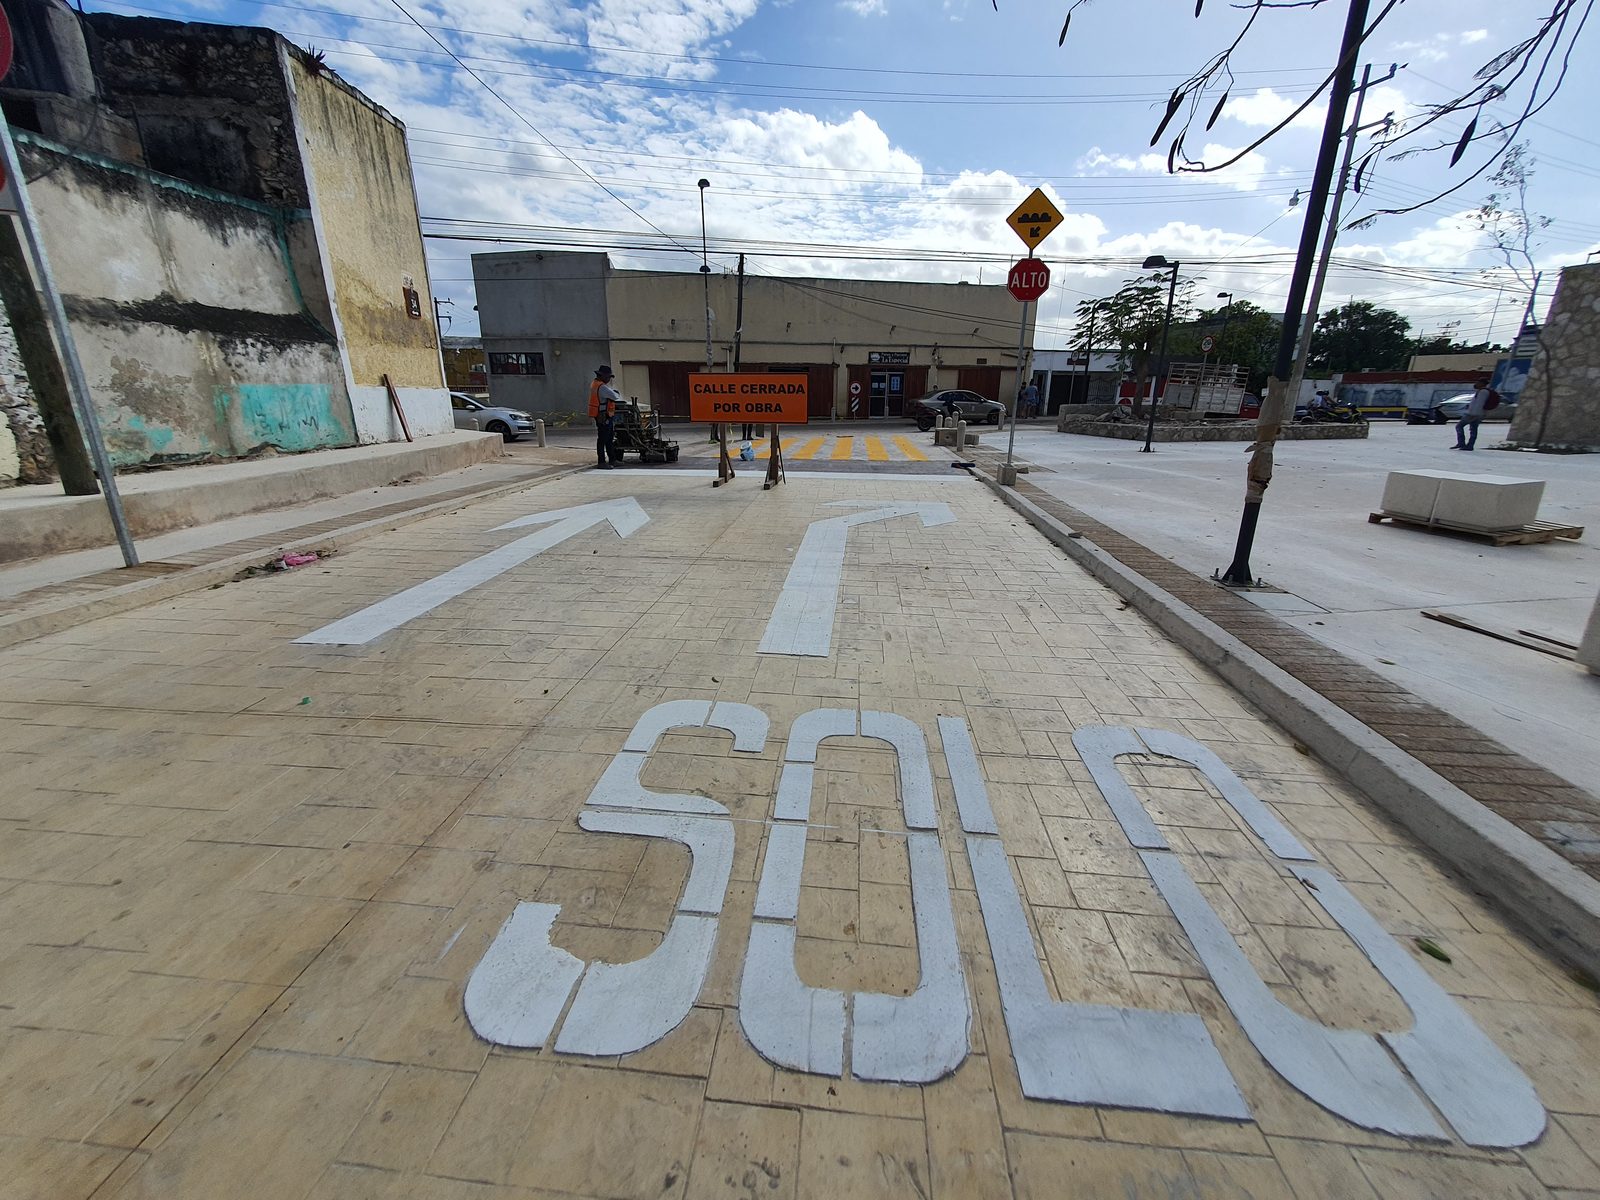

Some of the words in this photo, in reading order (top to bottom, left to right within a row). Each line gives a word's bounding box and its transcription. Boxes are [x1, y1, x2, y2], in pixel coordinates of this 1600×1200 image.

[1010, 271, 1047, 288] ALTO
[693, 383, 737, 394] CALLE
[740, 383, 806, 395] CERRADA
[713, 402, 741, 413] POR
[744, 402, 783, 413] OBRA
[463, 699, 1547, 1148] SOLO
